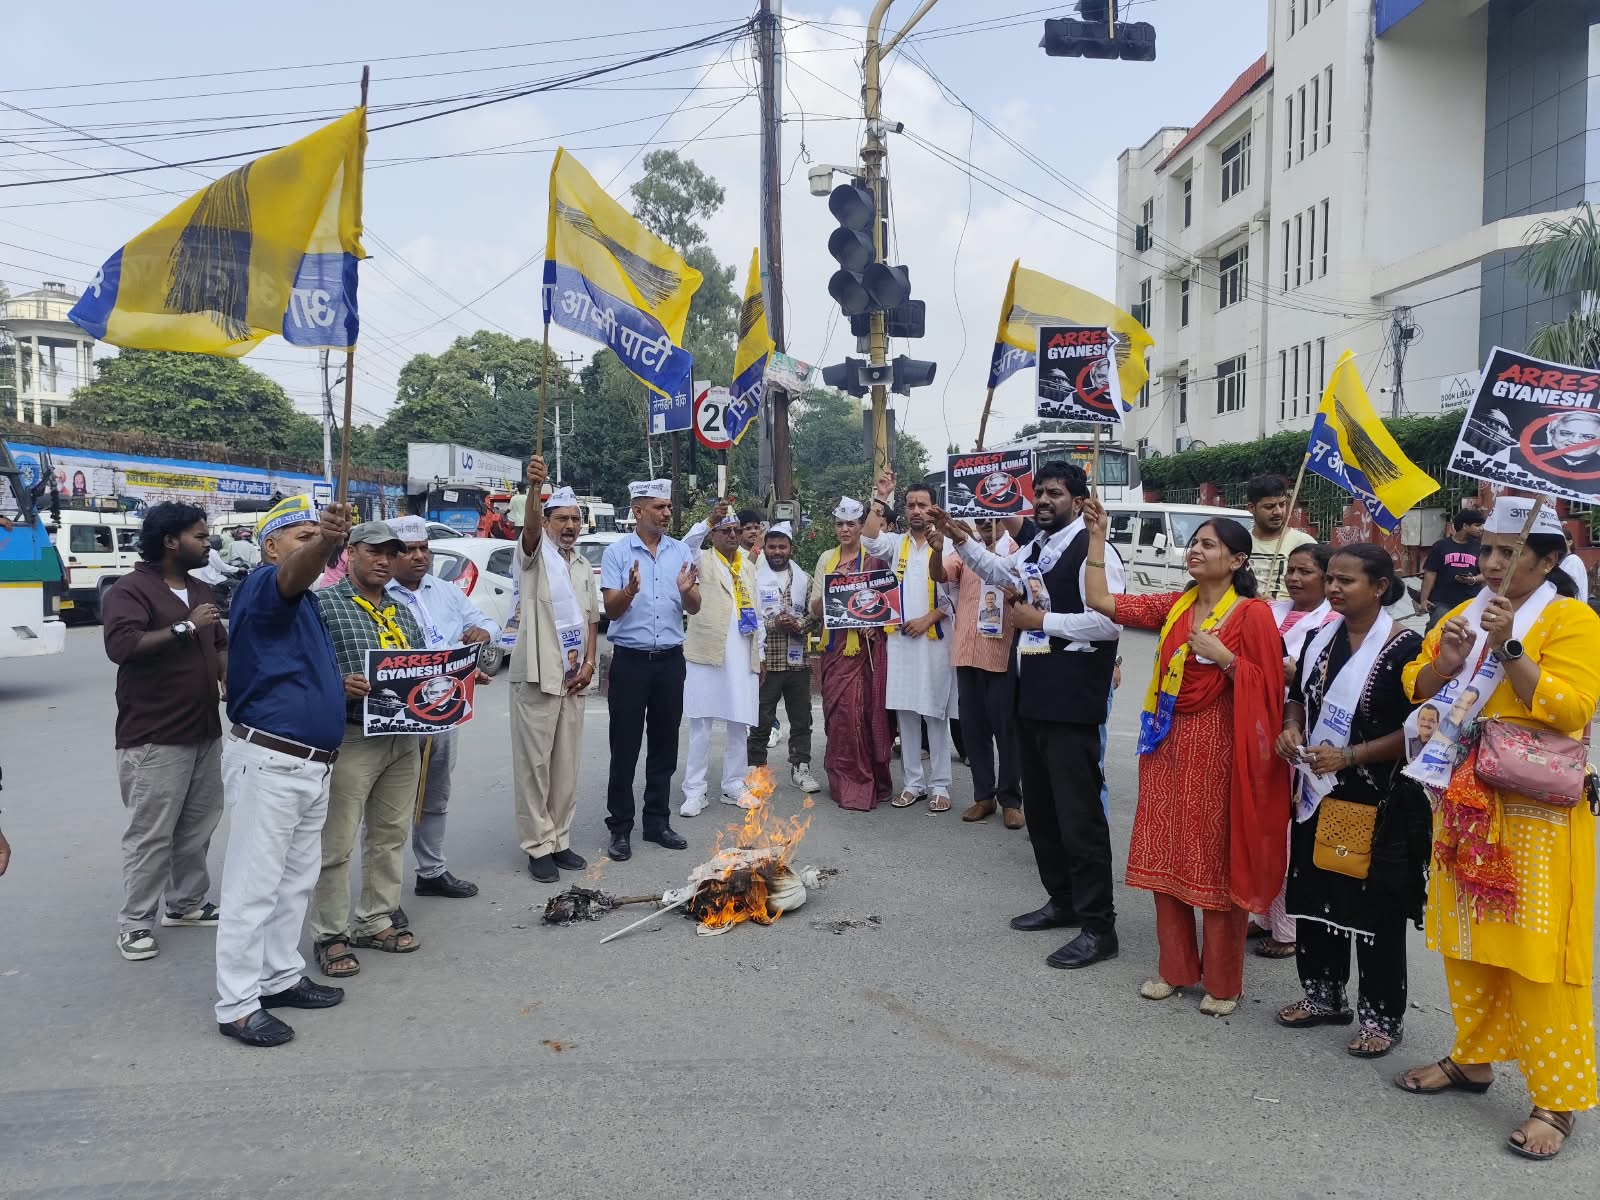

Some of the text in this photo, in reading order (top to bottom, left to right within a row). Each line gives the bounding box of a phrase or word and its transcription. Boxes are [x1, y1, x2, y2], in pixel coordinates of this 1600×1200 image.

[1497, 364, 1600, 392] ARRES
[1492, 380, 1594, 408] GYANESH
[953, 457, 1029, 478] GYANESH KUMAR
[954, 453, 1005, 469] ARREST
[829, 577, 895, 593] GYANESH KUMAR
[830, 574, 872, 586] ARREST
[561, 630, 581, 643] aap
[377, 651, 453, 669] ARREST
[377, 652, 477, 682] GYANESH KUMAR
